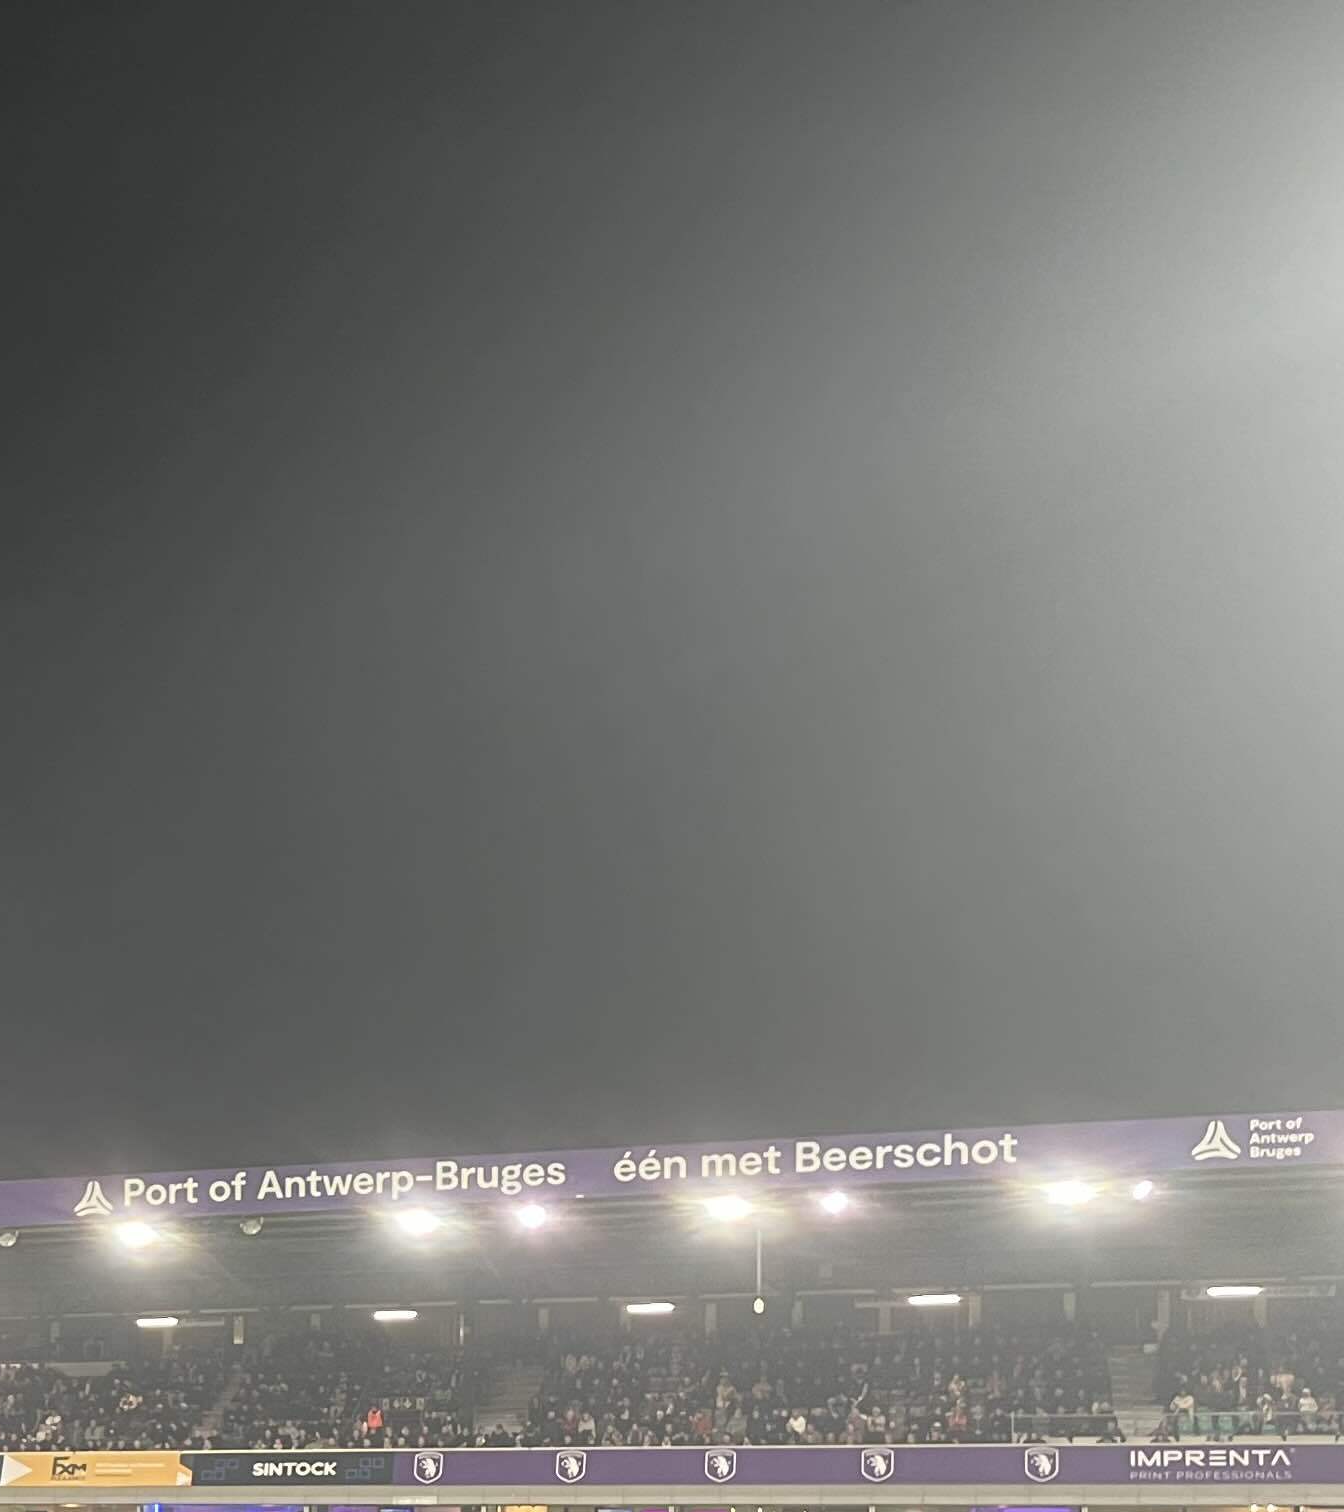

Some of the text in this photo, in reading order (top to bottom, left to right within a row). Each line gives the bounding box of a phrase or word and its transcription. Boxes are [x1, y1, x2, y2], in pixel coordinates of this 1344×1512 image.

[1250, 1116, 1302, 1130] Port of
[1250, 1132, 1314, 1145] Antwerp
[613, 1133, 1018, 1181] één met Beerschot
[1250, 1146, 1302, 1159] Bruges
[123, 1160, 566, 1206] Port of Antwerp-Bruges
[1130, 1449, 1291, 1467] IMPRENTA
[252, 1461, 337, 1477] SINTOCK
[1130, 1471, 1292, 1480] PRINT PROFESSIONALS
